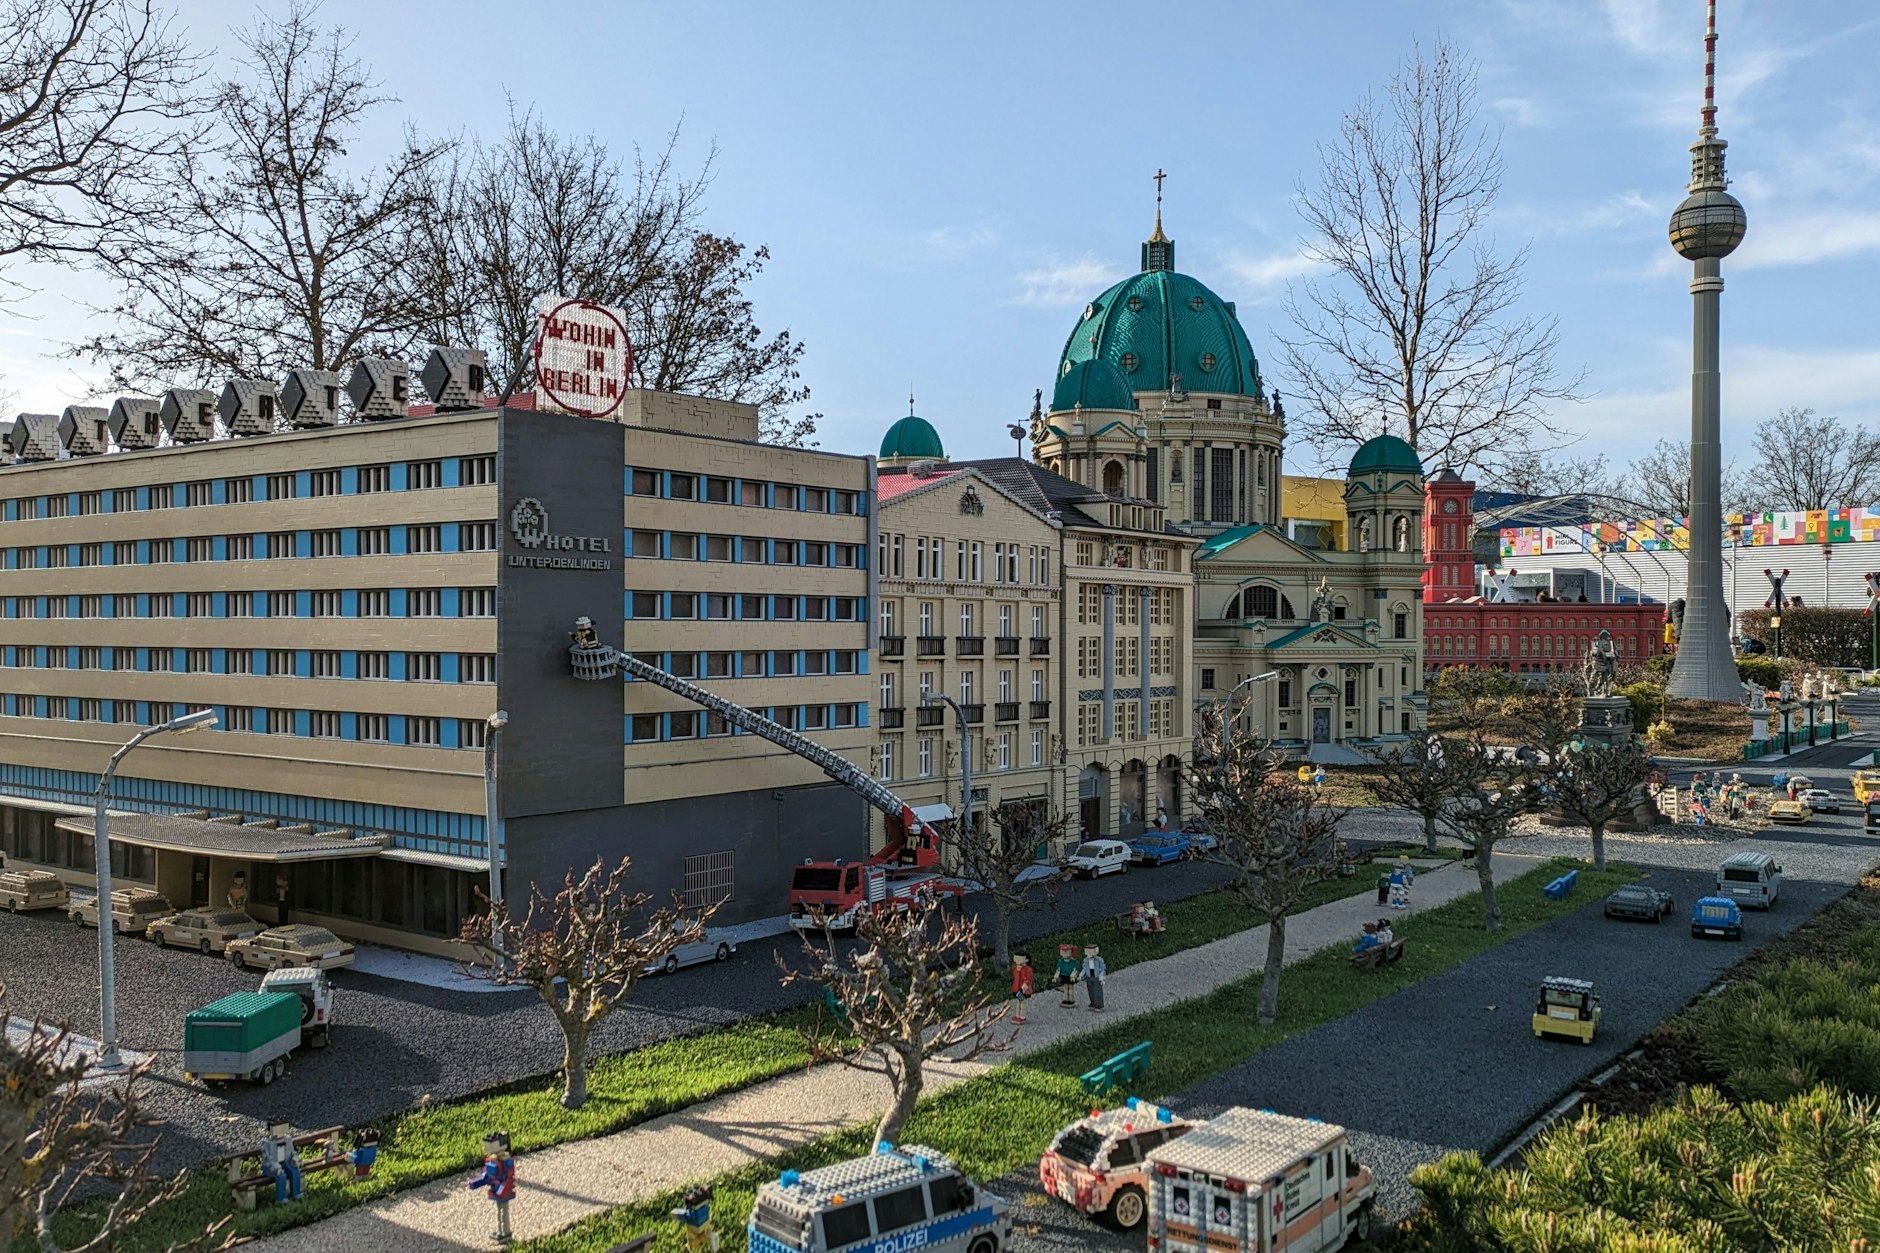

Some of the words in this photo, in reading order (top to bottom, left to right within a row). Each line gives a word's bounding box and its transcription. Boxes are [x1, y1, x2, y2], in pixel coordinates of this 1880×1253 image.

[547, 317, 615, 348] WOHIN
[586, 350, 604, 372] IN
[543, 368, 617, 398] BERLIN
[546, 535, 611, 552] HOTEL
[875, 1228, 928, 1253] POLIZEI
